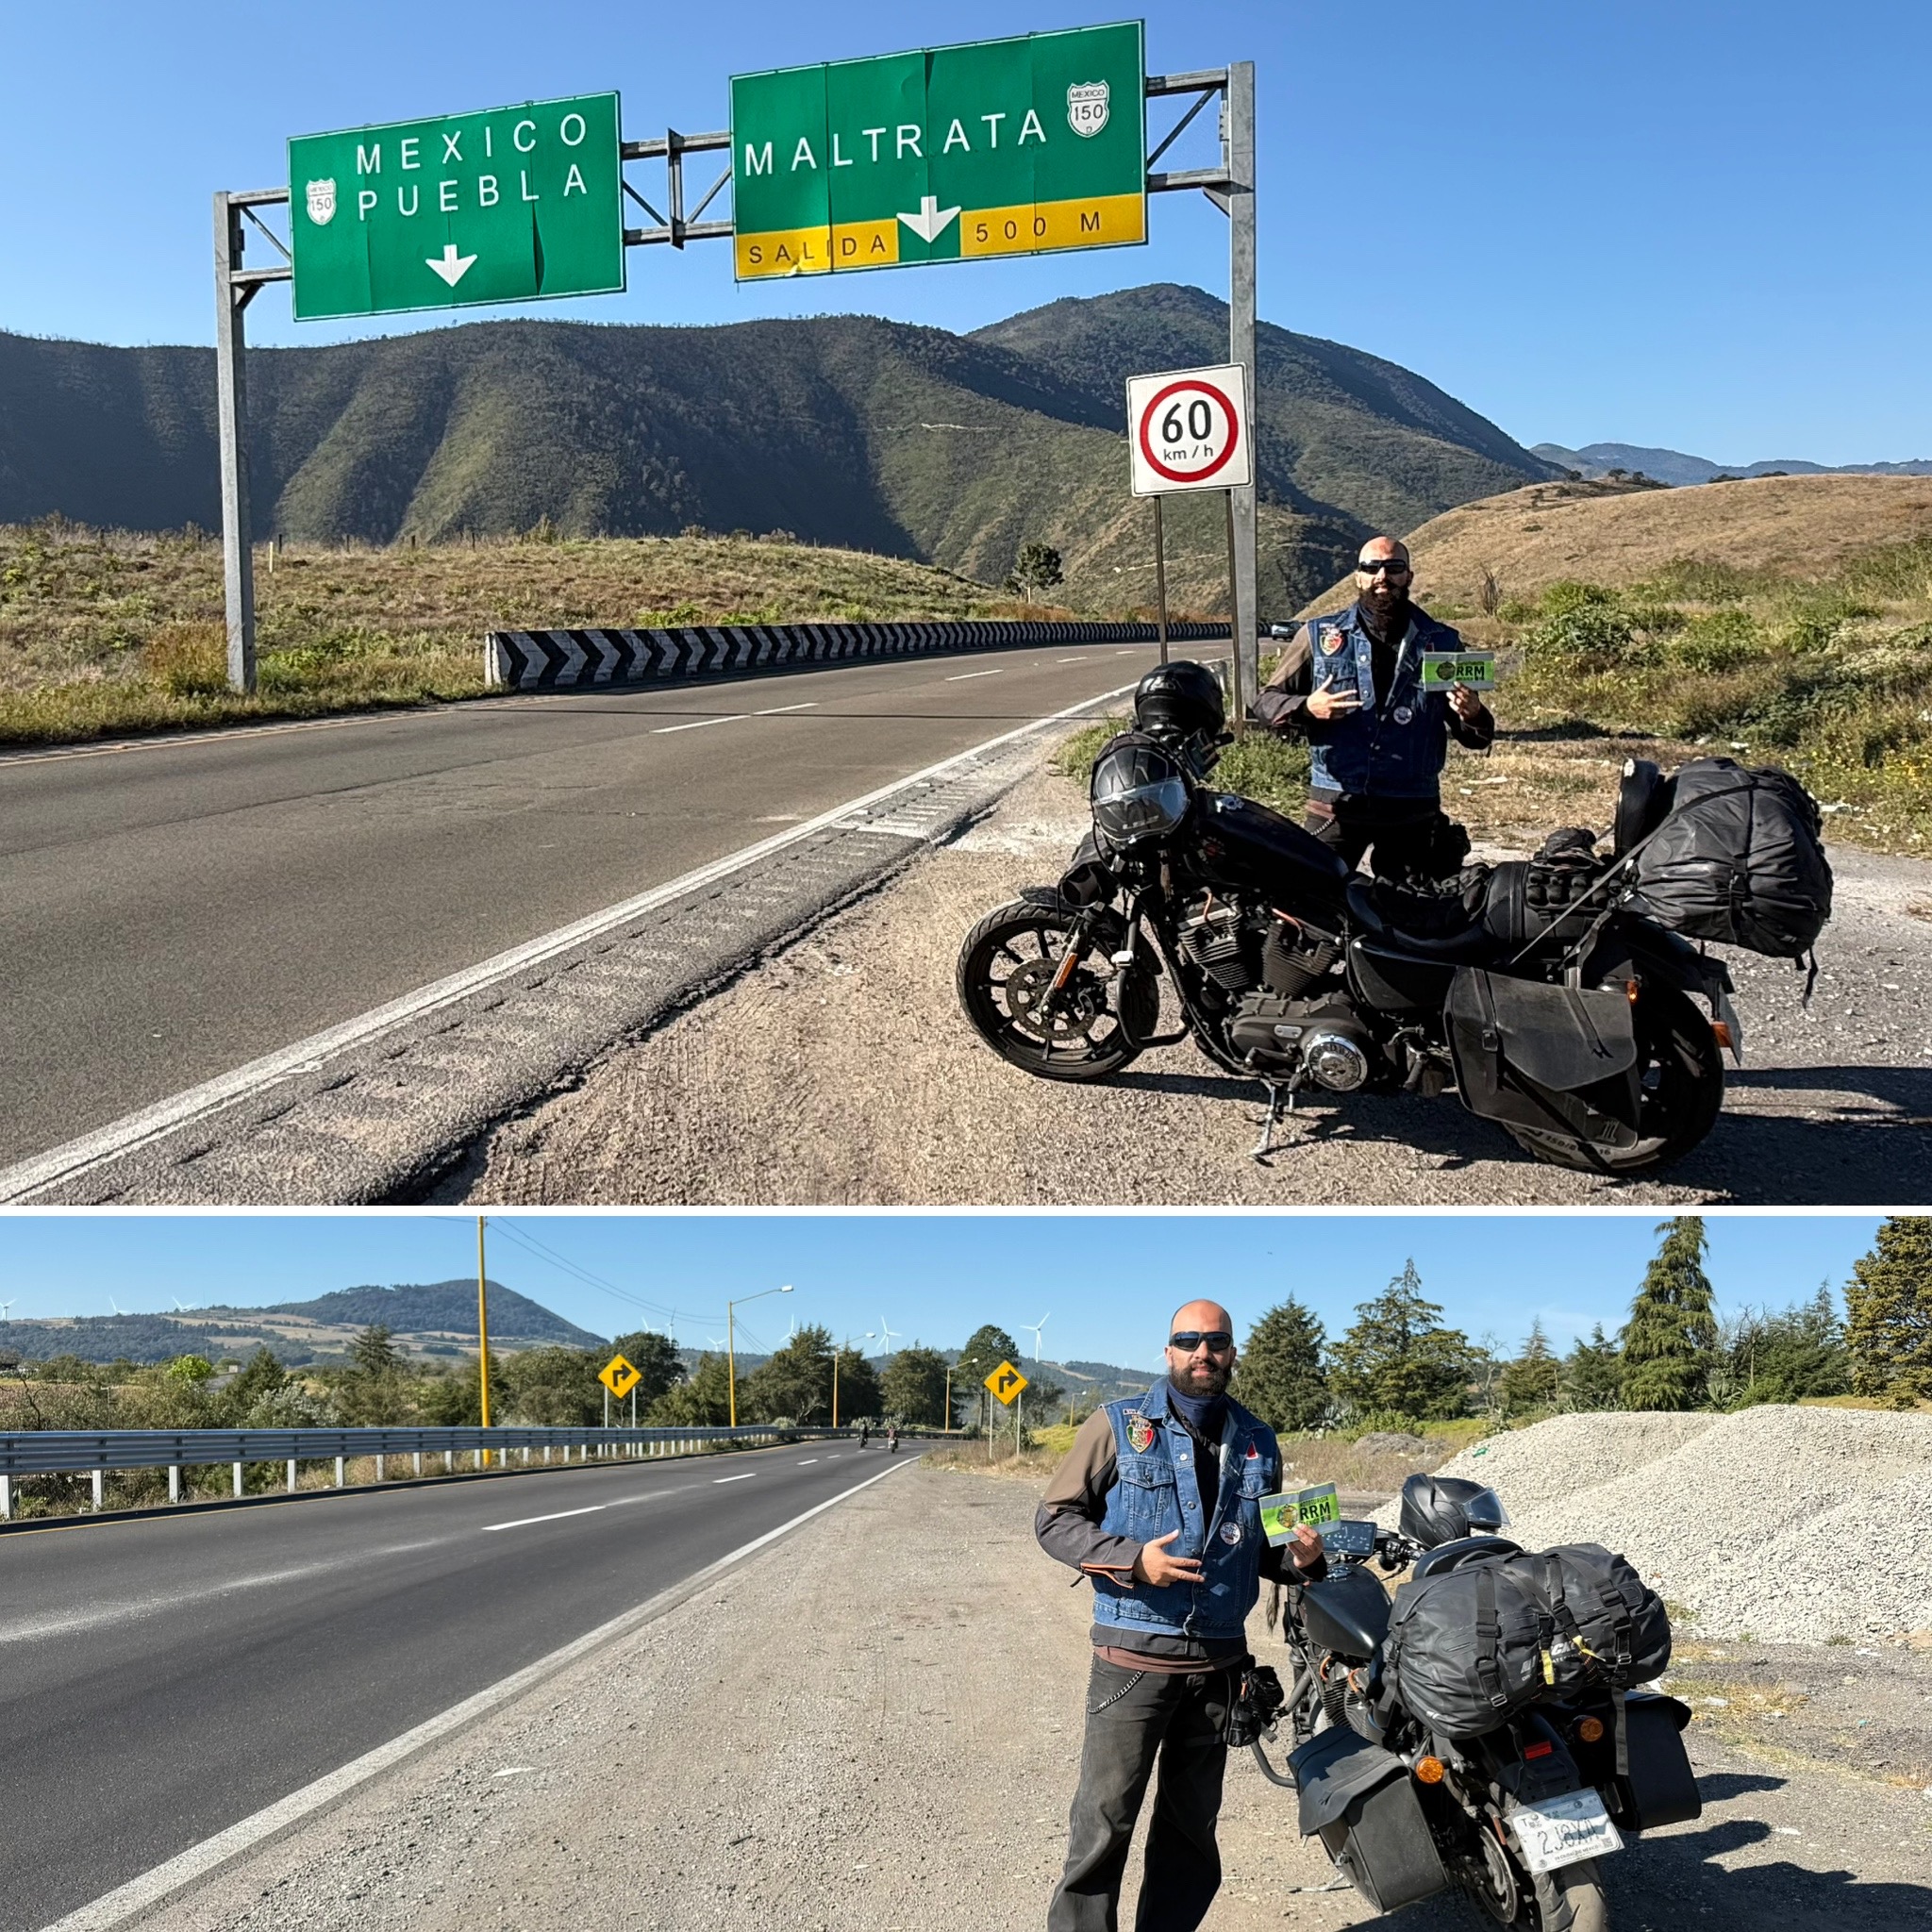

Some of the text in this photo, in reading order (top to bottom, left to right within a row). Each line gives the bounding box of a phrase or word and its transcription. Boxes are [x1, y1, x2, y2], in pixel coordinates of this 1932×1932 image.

[1072, 90, 1105, 98] MEXICO
[1074, 104, 1104, 121] 150
[357, 113, 587, 175] MEXICO
[744, 108, 1047, 176] MALTRATA
[358, 164, 588, 221] PUEBLA
[311, 197, 332, 211] 150
[748, 210, 1101, 263] SALIDA 500 M
[1162, 400, 1211, 443] 60
[1163, 448, 1187, 461] km
[1204, 444, 1214, 458] h
[1457, 665, 1484, 676] RRM
[1300, 1502, 1330, 1520] RRM
